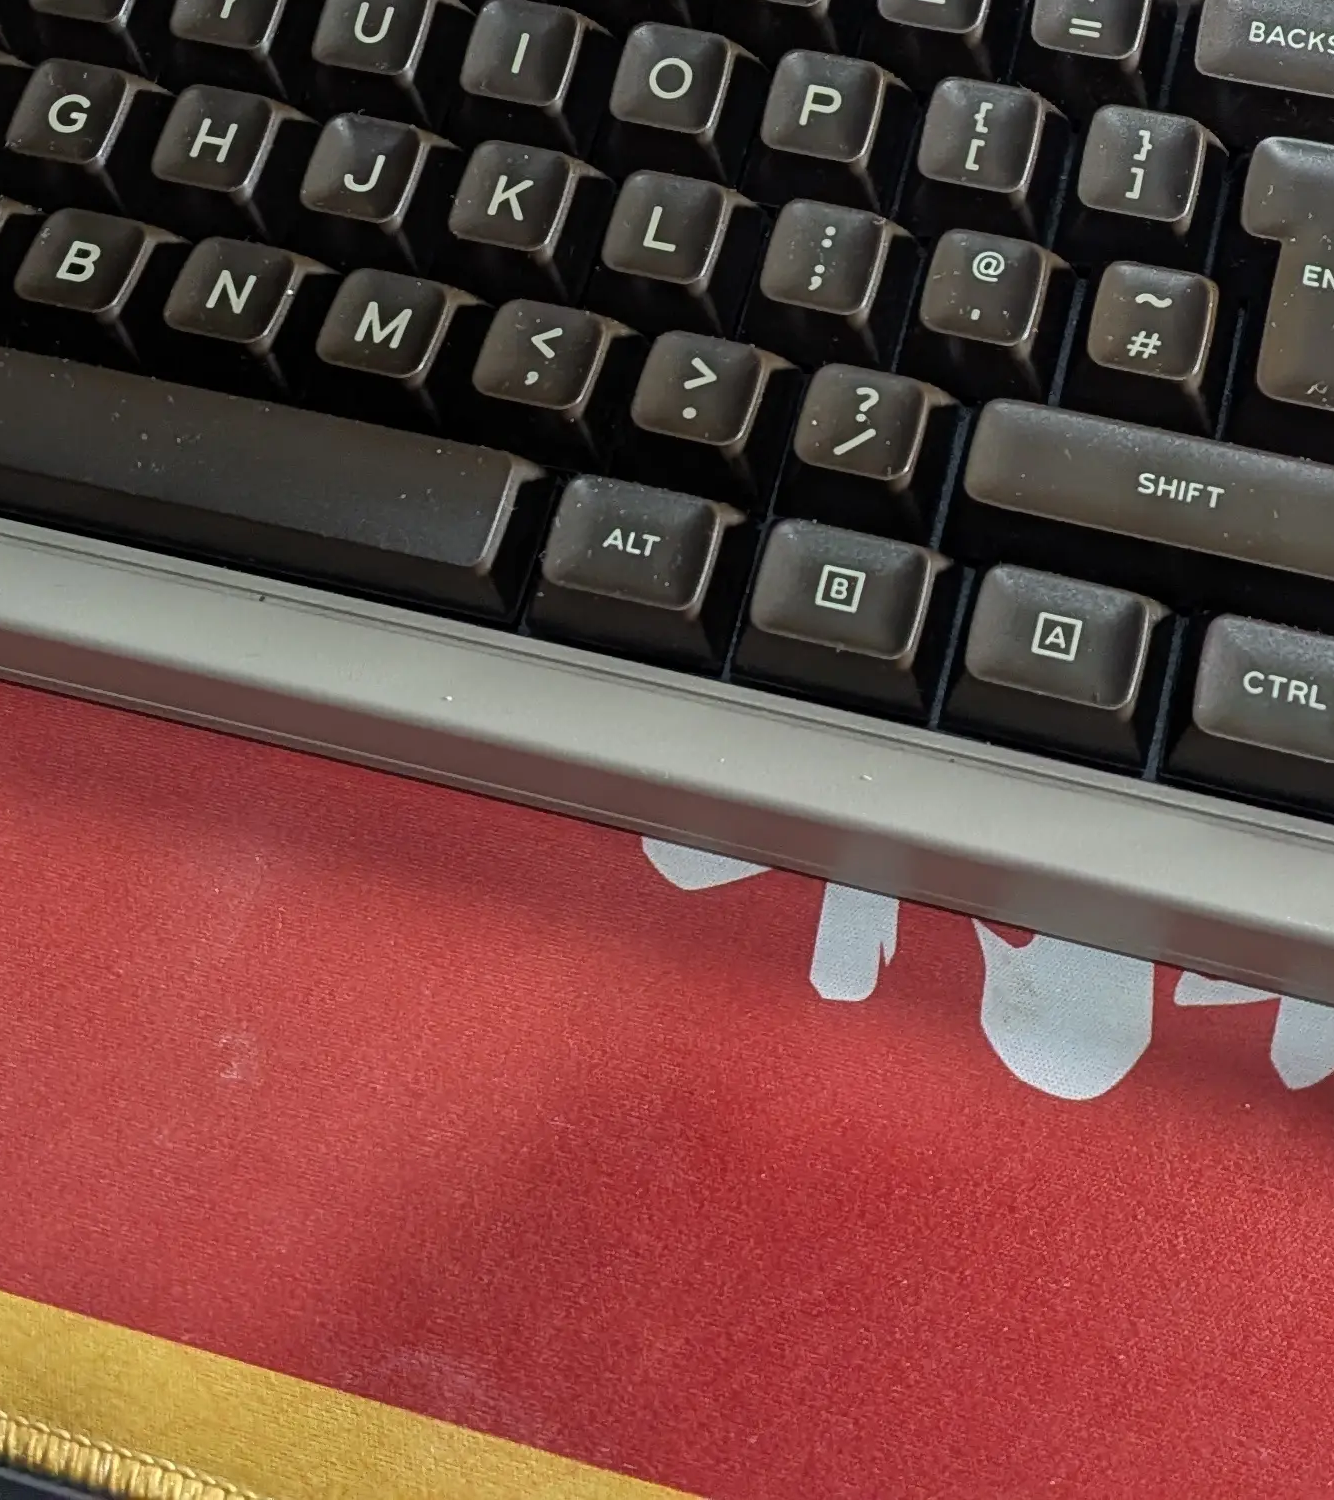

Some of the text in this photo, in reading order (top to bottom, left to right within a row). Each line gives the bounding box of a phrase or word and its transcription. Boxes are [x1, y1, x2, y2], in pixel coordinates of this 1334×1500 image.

[354, 1, 395, 44] U
[511, 32, 530, 74] I
[648, 57, 693, 100] O
[48, 93, 91, 134] G
[798, 84, 842, 126] P
[974, 101, 994, 134] {
[189, 117, 238, 163] H
[965, 138, 986, 171] [
[1133, 129, 1153, 162] }
[343, 154, 386, 192] J
[1125, 167, 1145, 200] ]
[487, 174, 534, 221] K
[642, 205, 676, 252] L
[55, 240, 101, 283] B
[972, 251, 1005, 283] @
[205, 269, 257, 314] N
[354, 301, 413, 349] M
[530, 327, 563, 359] <
[1126, 330, 1162, 359] #
[683, 357, 718, 390] >
[855, 386, 880, 423] ?
[1137, 472, 1225, 508] SHIFT
[602, 528, 661, 557] ALT
[1243, 670, 1327, 711] CTRL
